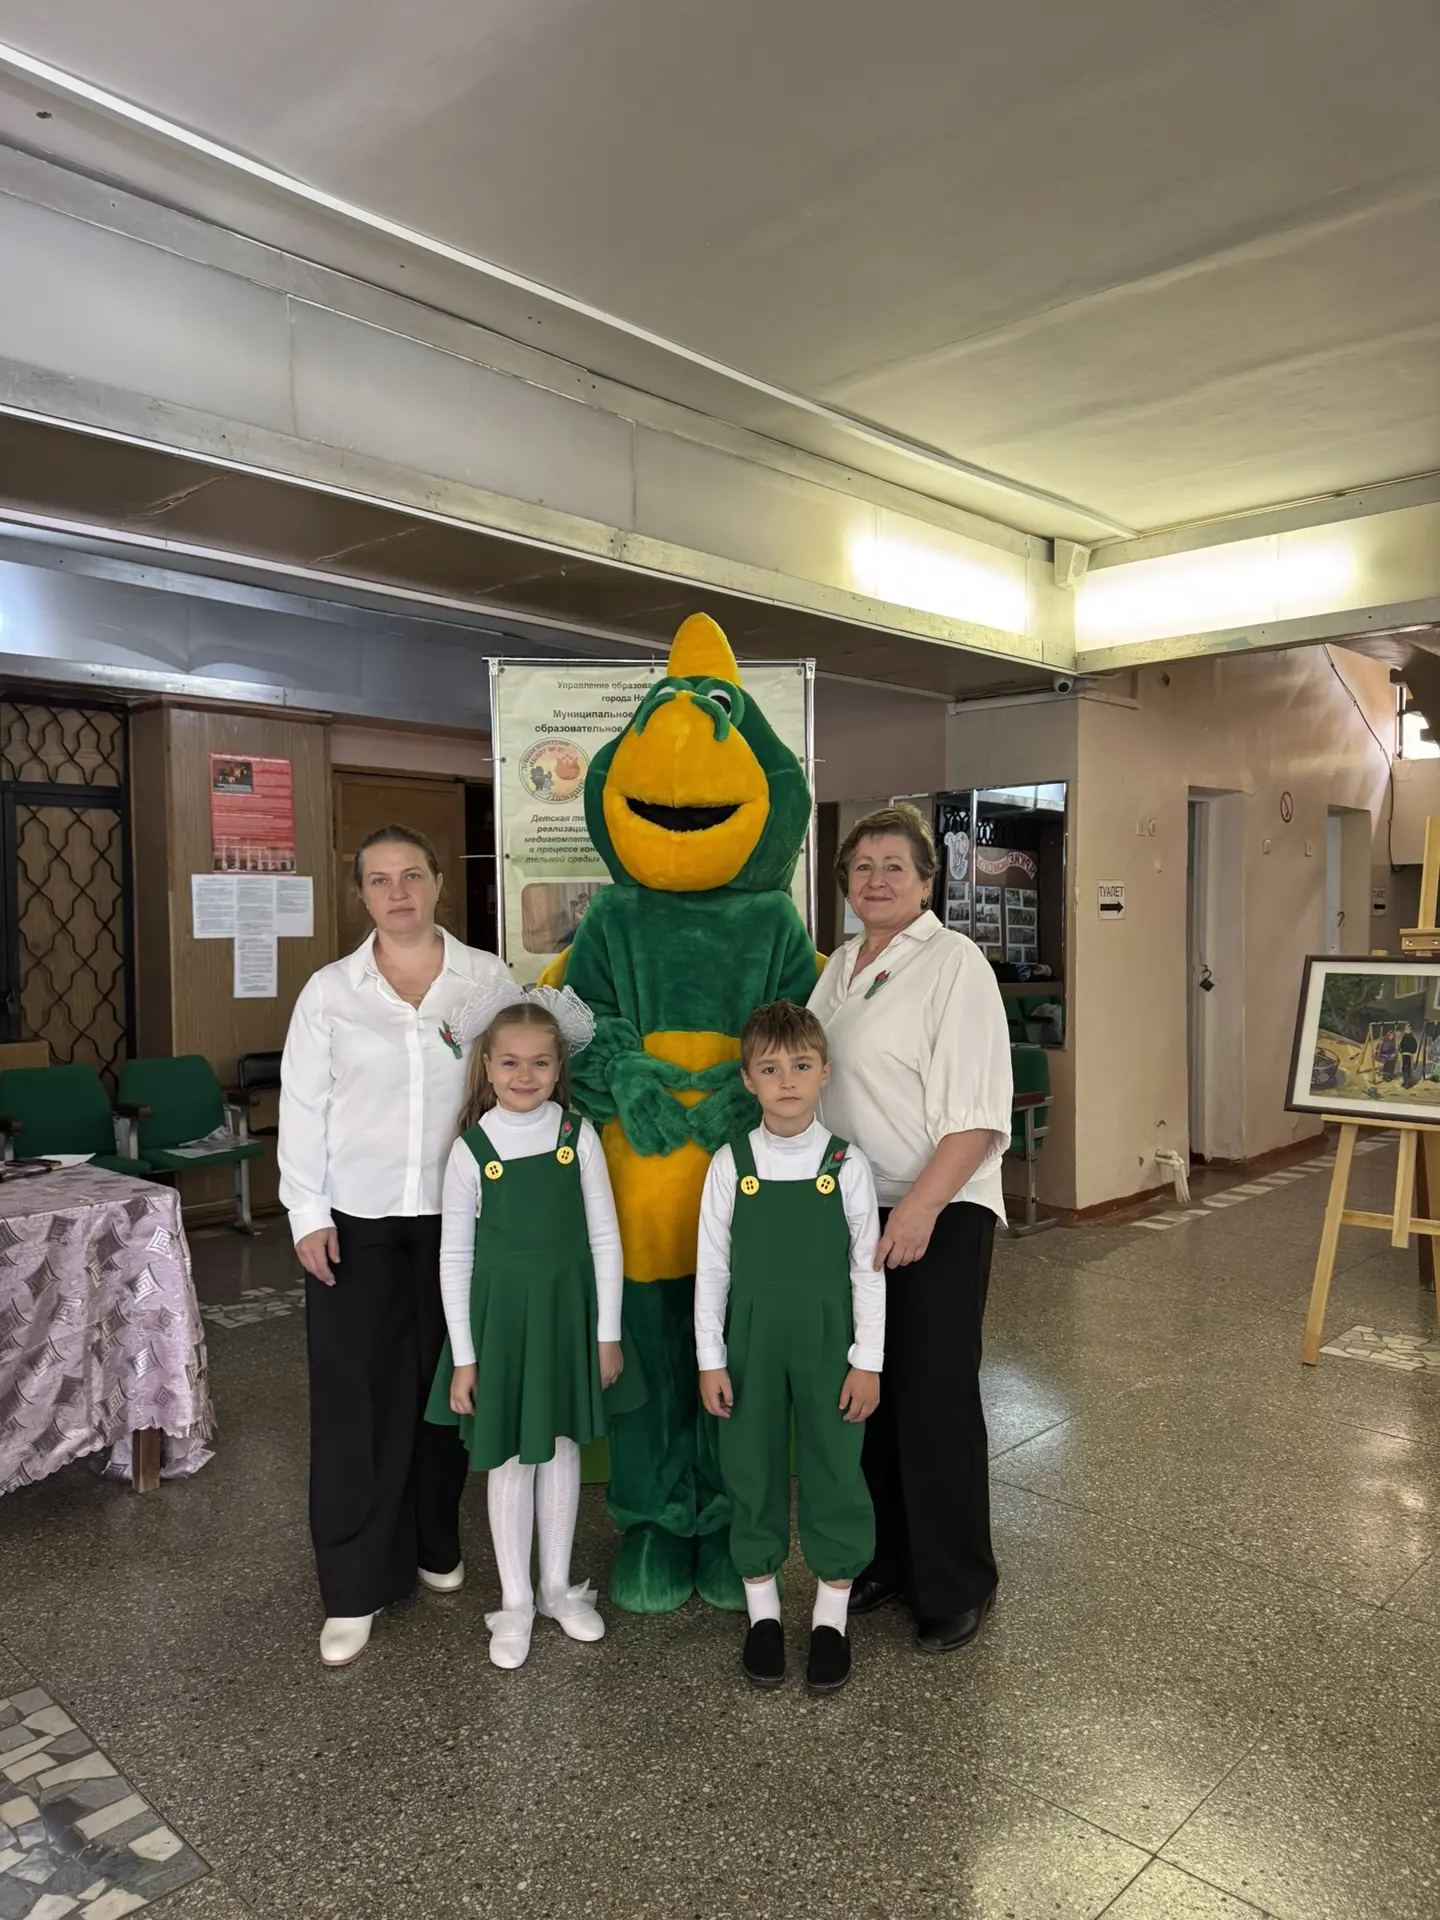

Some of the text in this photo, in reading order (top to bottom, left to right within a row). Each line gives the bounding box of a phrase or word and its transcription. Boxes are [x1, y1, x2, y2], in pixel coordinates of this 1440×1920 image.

[557, 681, 652, 690] Управление образова
[602, 694, 645, 703] города Но
[553, 710, 634, 720] Муниципальное
[535, 724, 623, 734] образовательное
[530, 814, 570, 823] Детская
[536, 846, 578, 855] процессе
[1099, 886, 1124, 897] ТУАЛЕТ
